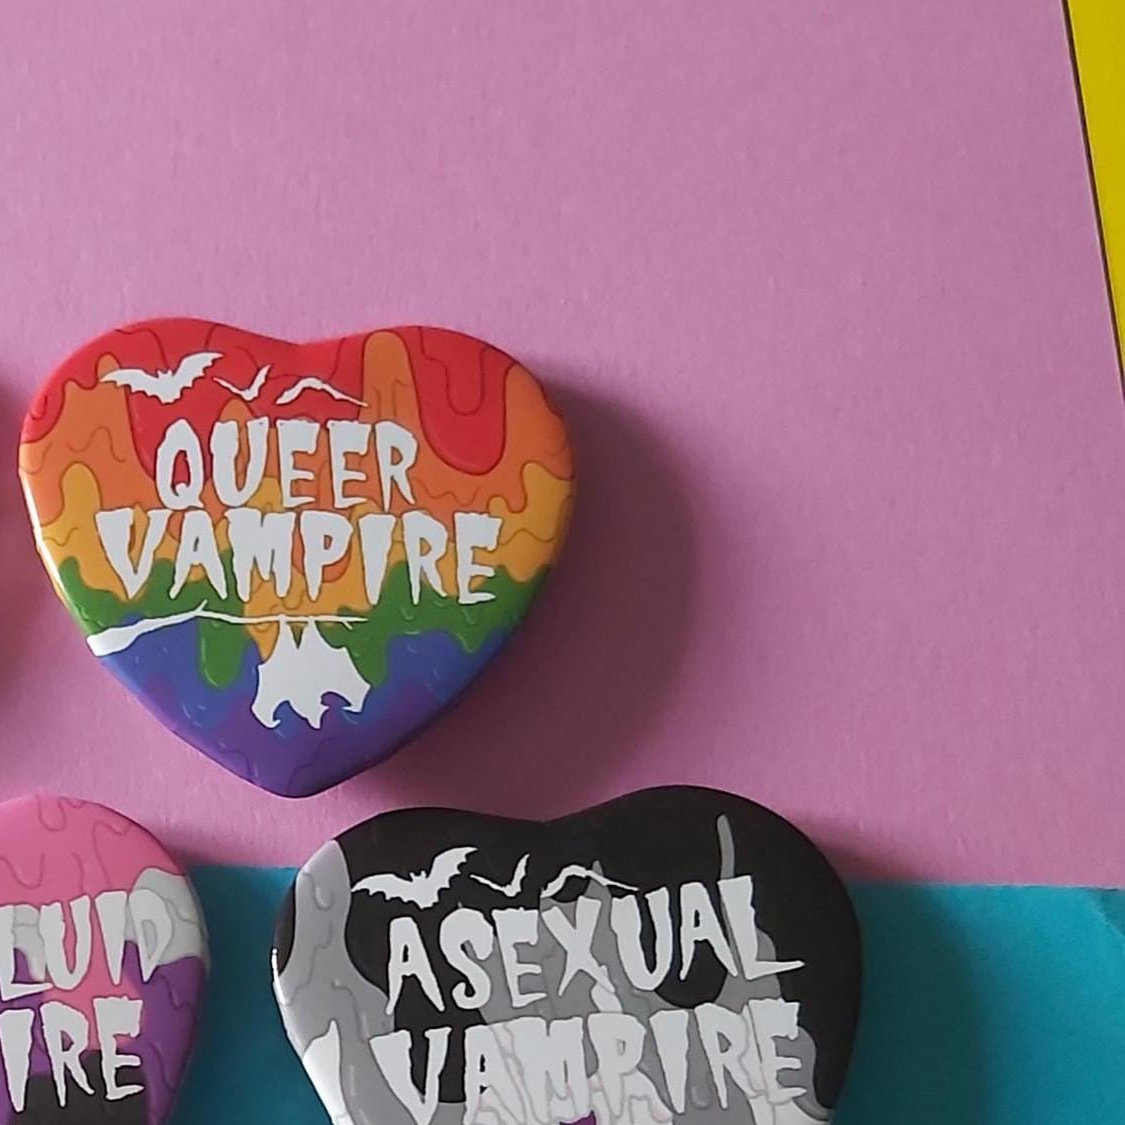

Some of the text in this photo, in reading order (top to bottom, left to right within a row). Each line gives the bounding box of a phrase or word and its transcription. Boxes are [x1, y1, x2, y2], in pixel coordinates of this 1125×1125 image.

[154, 418, 419, 511] QUEER
[95, 506, 503, 605] VAMPIRE
[385, 875, 806, 1015] ASEXUAL
